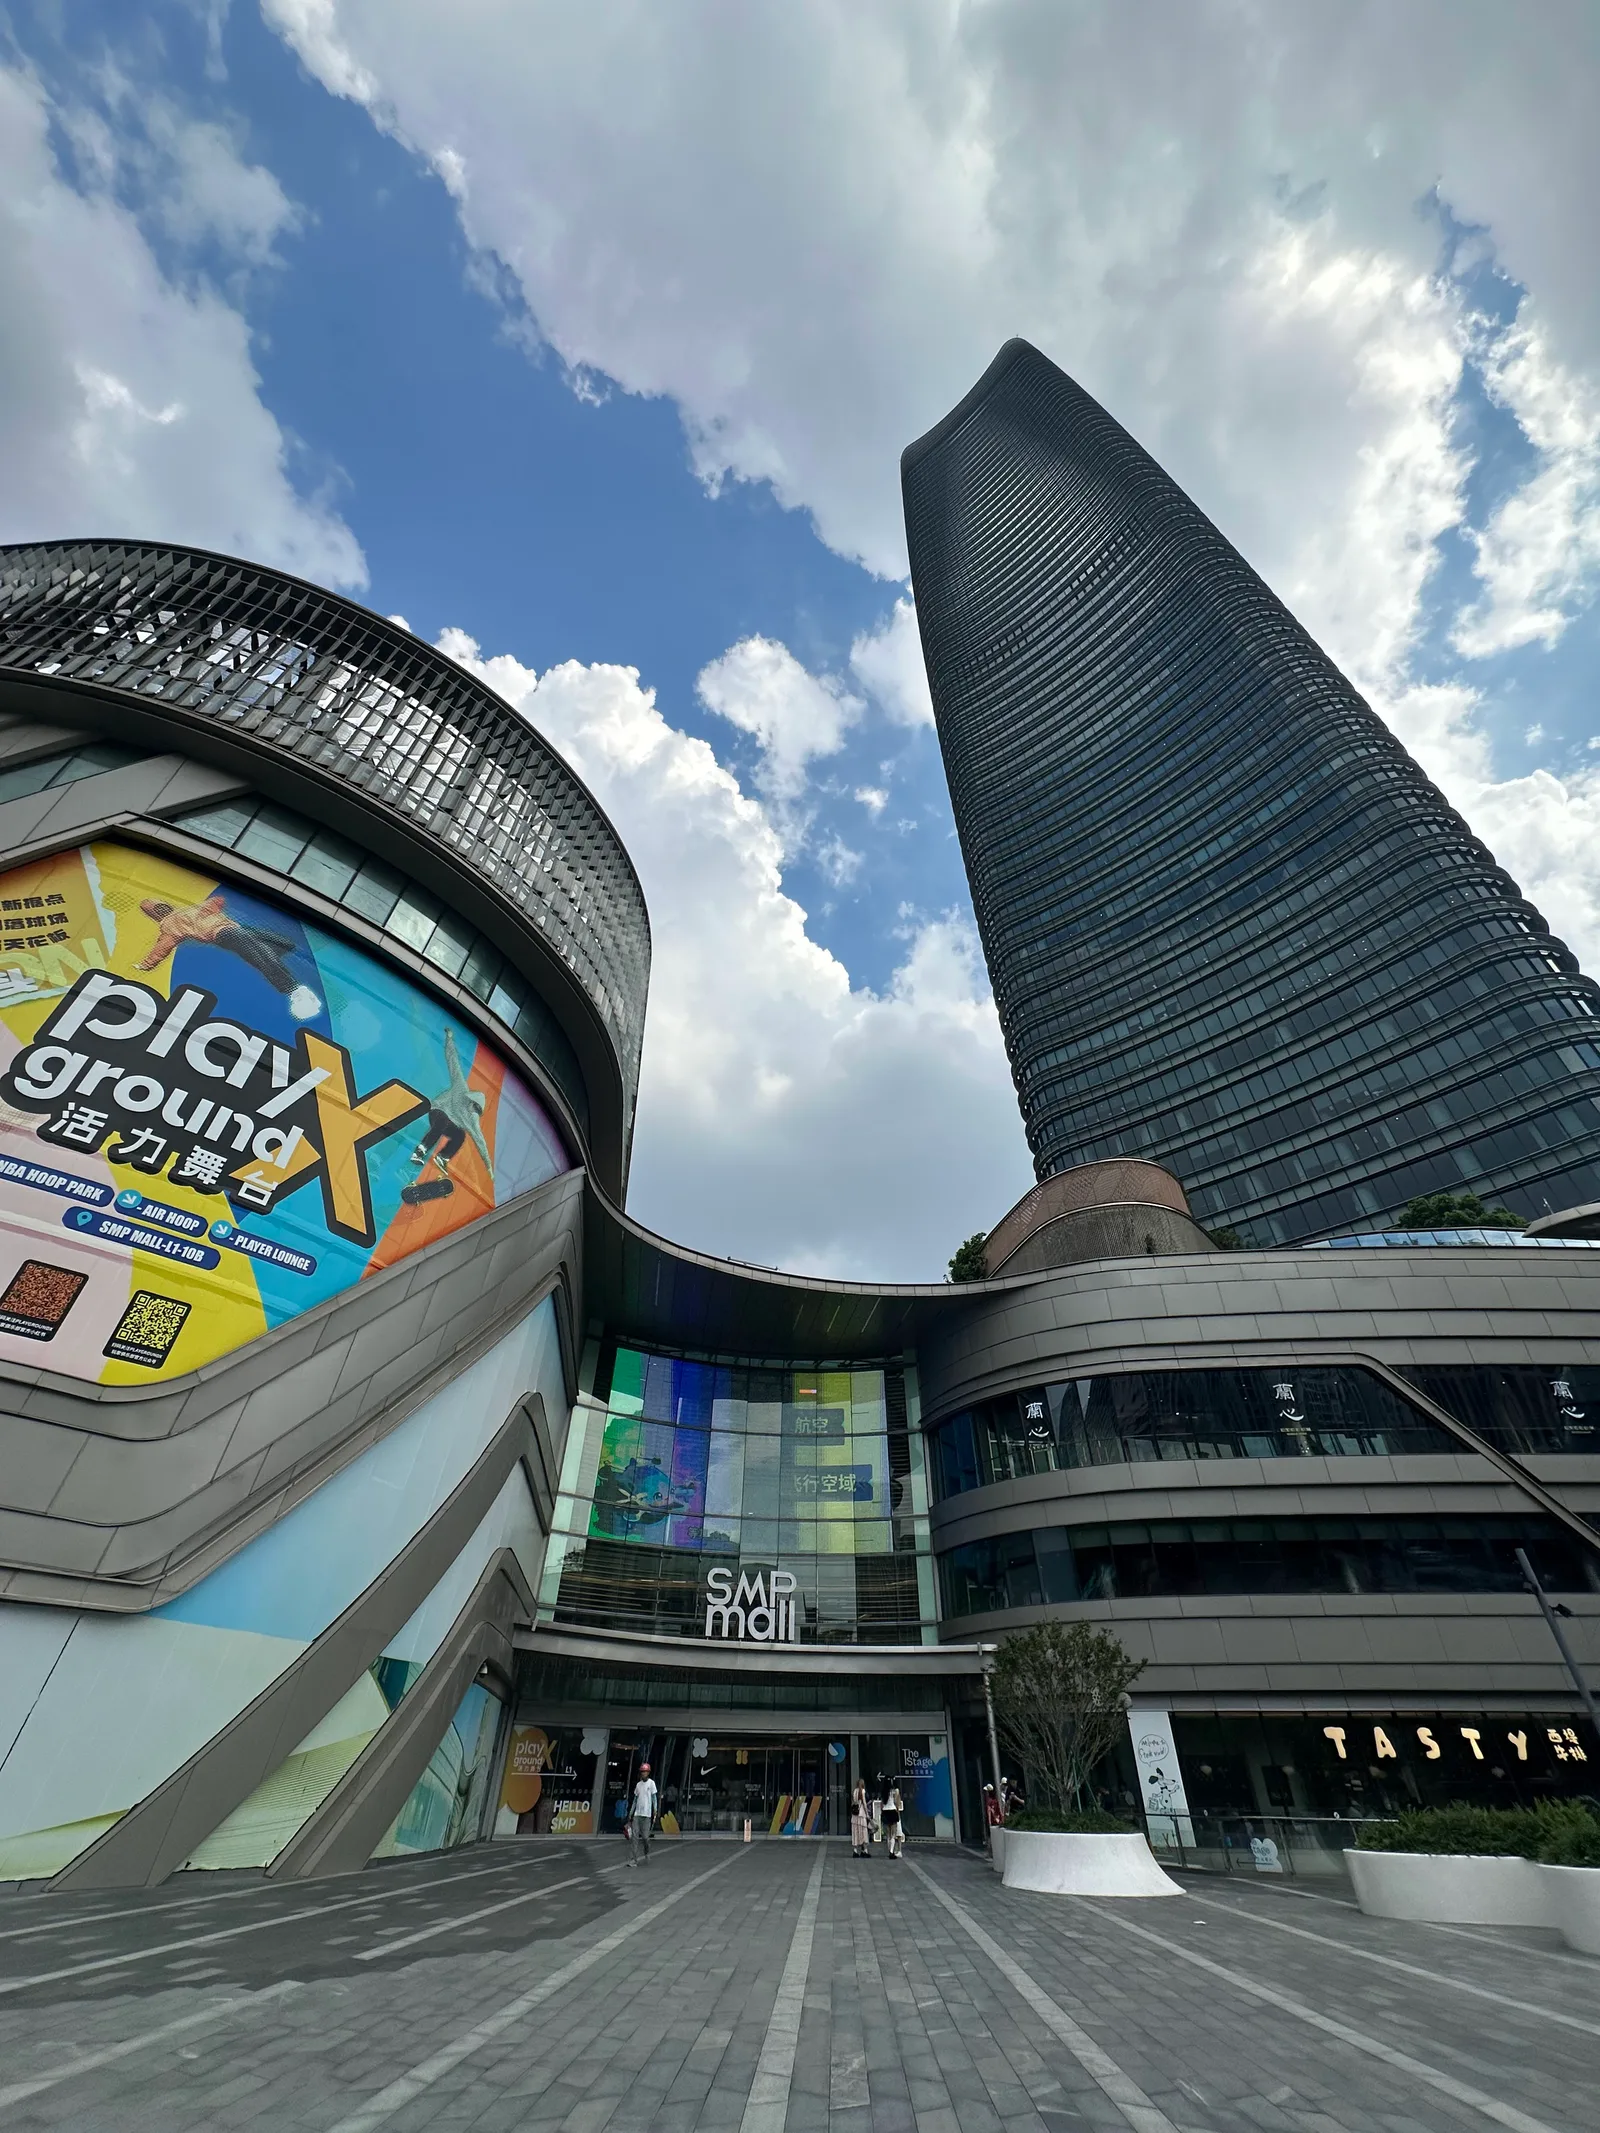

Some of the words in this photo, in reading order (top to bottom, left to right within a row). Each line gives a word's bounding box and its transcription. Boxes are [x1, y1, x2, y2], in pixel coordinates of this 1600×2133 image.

[0, 893, 66, 912] 新据点
[0, 929, 71, 951] 天花板
[48, 973, 332, 1119] play
[14, 1045, 305, 1169] ground
[49, 1102, 277, 1206] 活力舞台
[0, 1160, 27, 1179] NBA
[25, 1168, 68, 1193] HOOP
[66, 1182, 105, 1202] PARK
[142, 1204, 165, 1222] AIR
[163, 1210, 200, 1231] HOOP
[99, 1220, 131, 1240] SMP
[129, 1229, 206, 1263] MALL-L1-10B
[236, 1234, 273, 1257] PLAYER
[271, 1246, 310, 1271] LOUNGE
[706, 1567, 797, 1608] SMP
[705, 1599, 796, 1641] mall
[515, 1740, 545, 1757] play
[902, 1749, 919, 1766] The
[1323, 1726, 1528, 1760] TASTY
[513, 1756, 544, 1767] ground
[906, 1757, 933, 1768] Stage
[553, 1800, 590, 1813] HELLO
[550, 1817, 577, 1831] SMP
